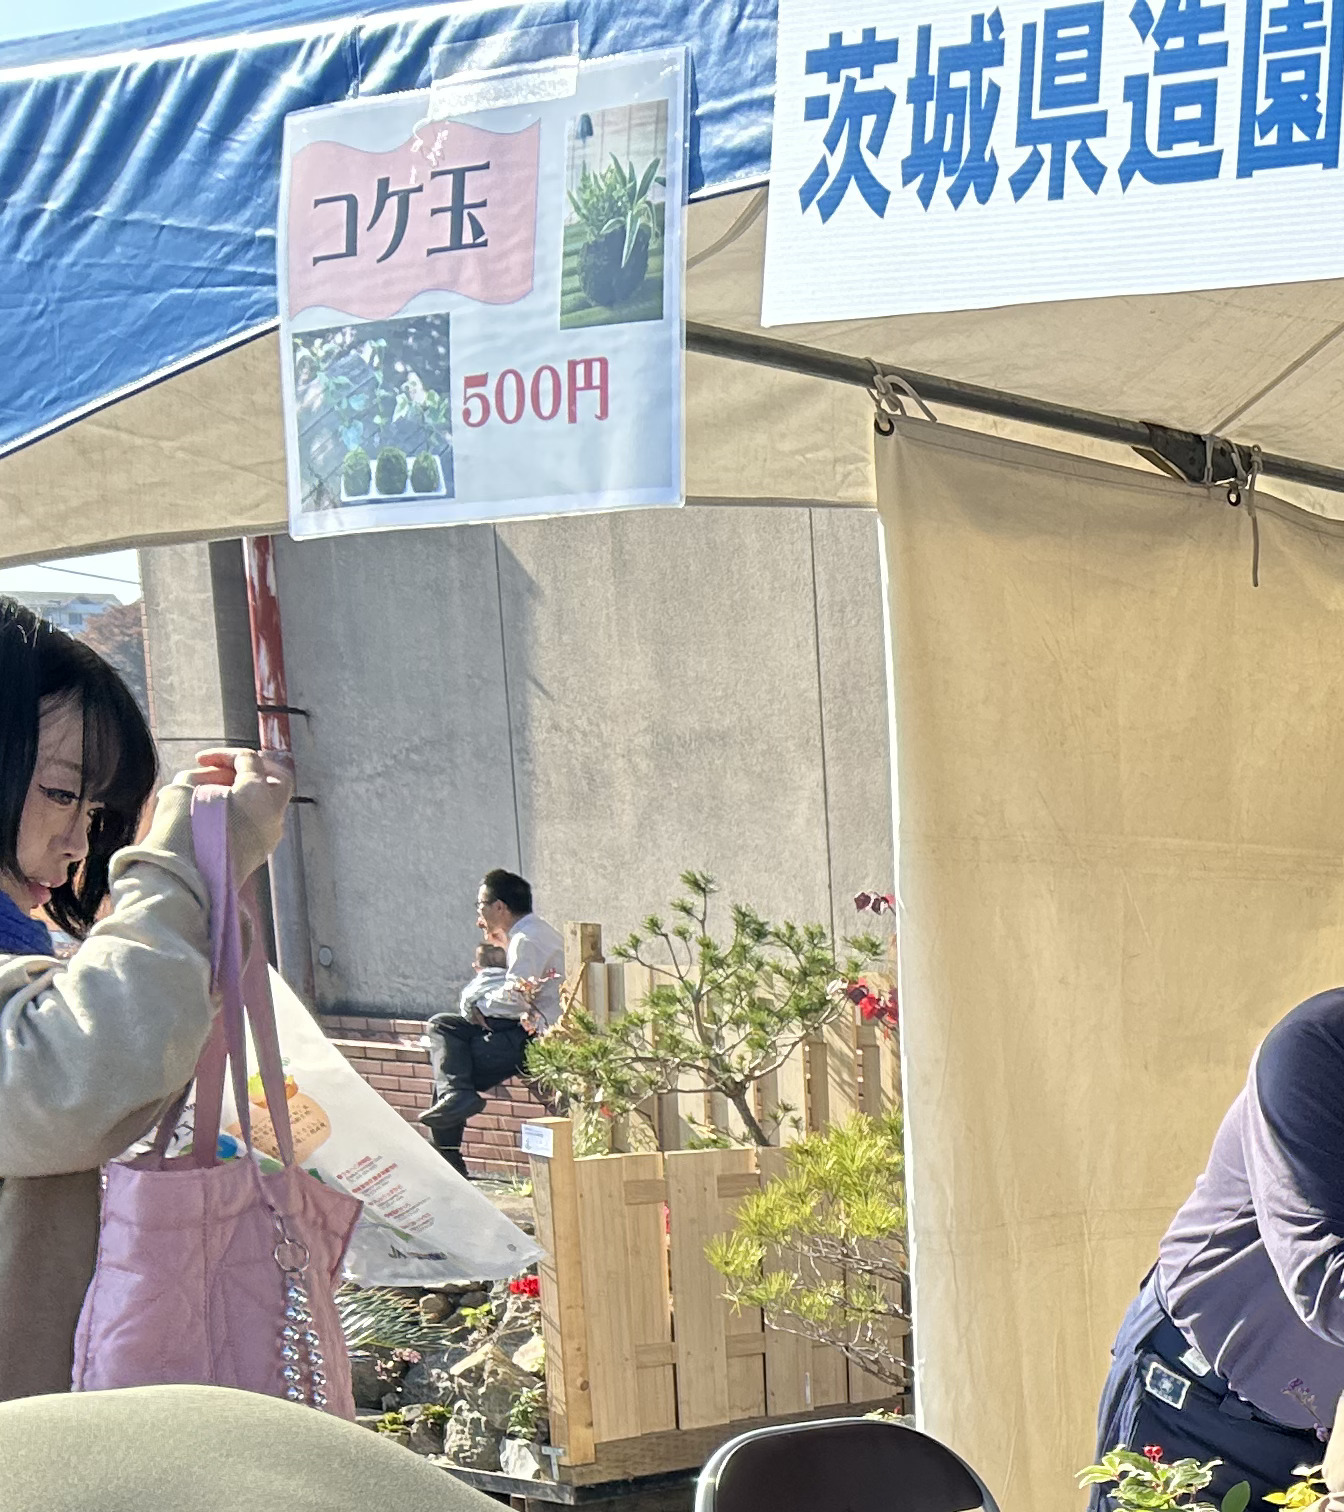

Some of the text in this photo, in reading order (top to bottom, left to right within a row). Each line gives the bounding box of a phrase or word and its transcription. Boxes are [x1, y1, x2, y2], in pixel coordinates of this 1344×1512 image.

[311, 160, 491, 268] コケ玉
[460, 356, 610, 428] 500円
